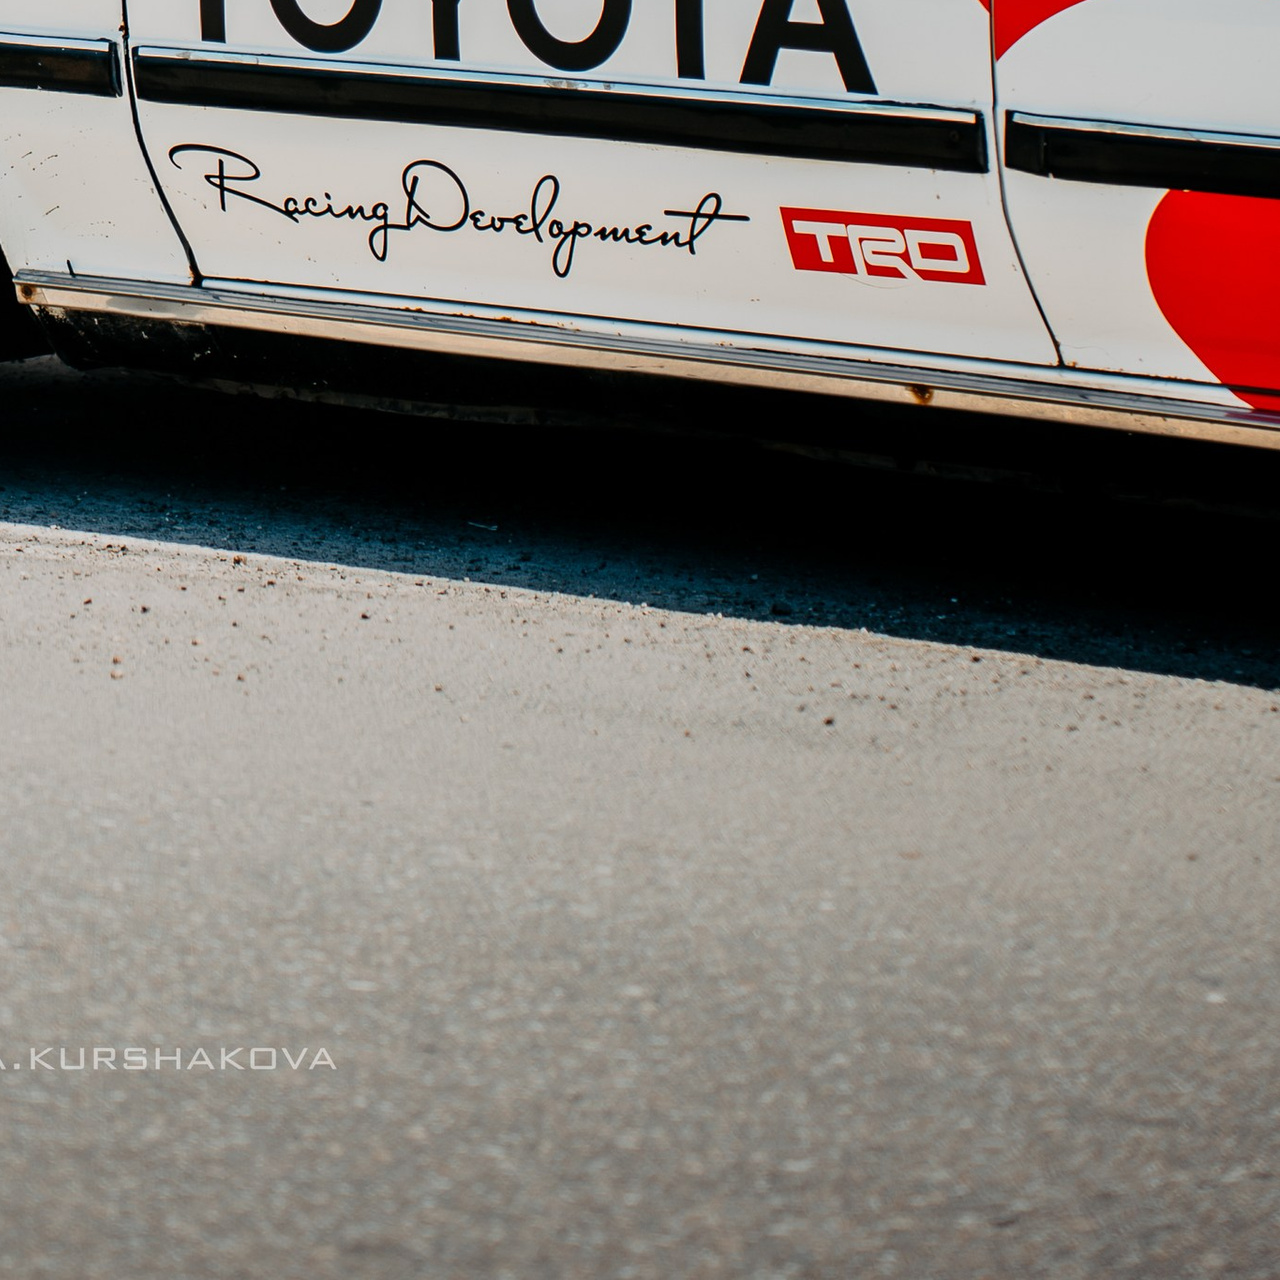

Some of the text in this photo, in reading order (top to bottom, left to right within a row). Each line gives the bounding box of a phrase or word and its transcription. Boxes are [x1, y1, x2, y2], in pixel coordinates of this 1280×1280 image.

[168, 143, 751, 279] Racing Development
[791, 219, 971, 280] TRD
